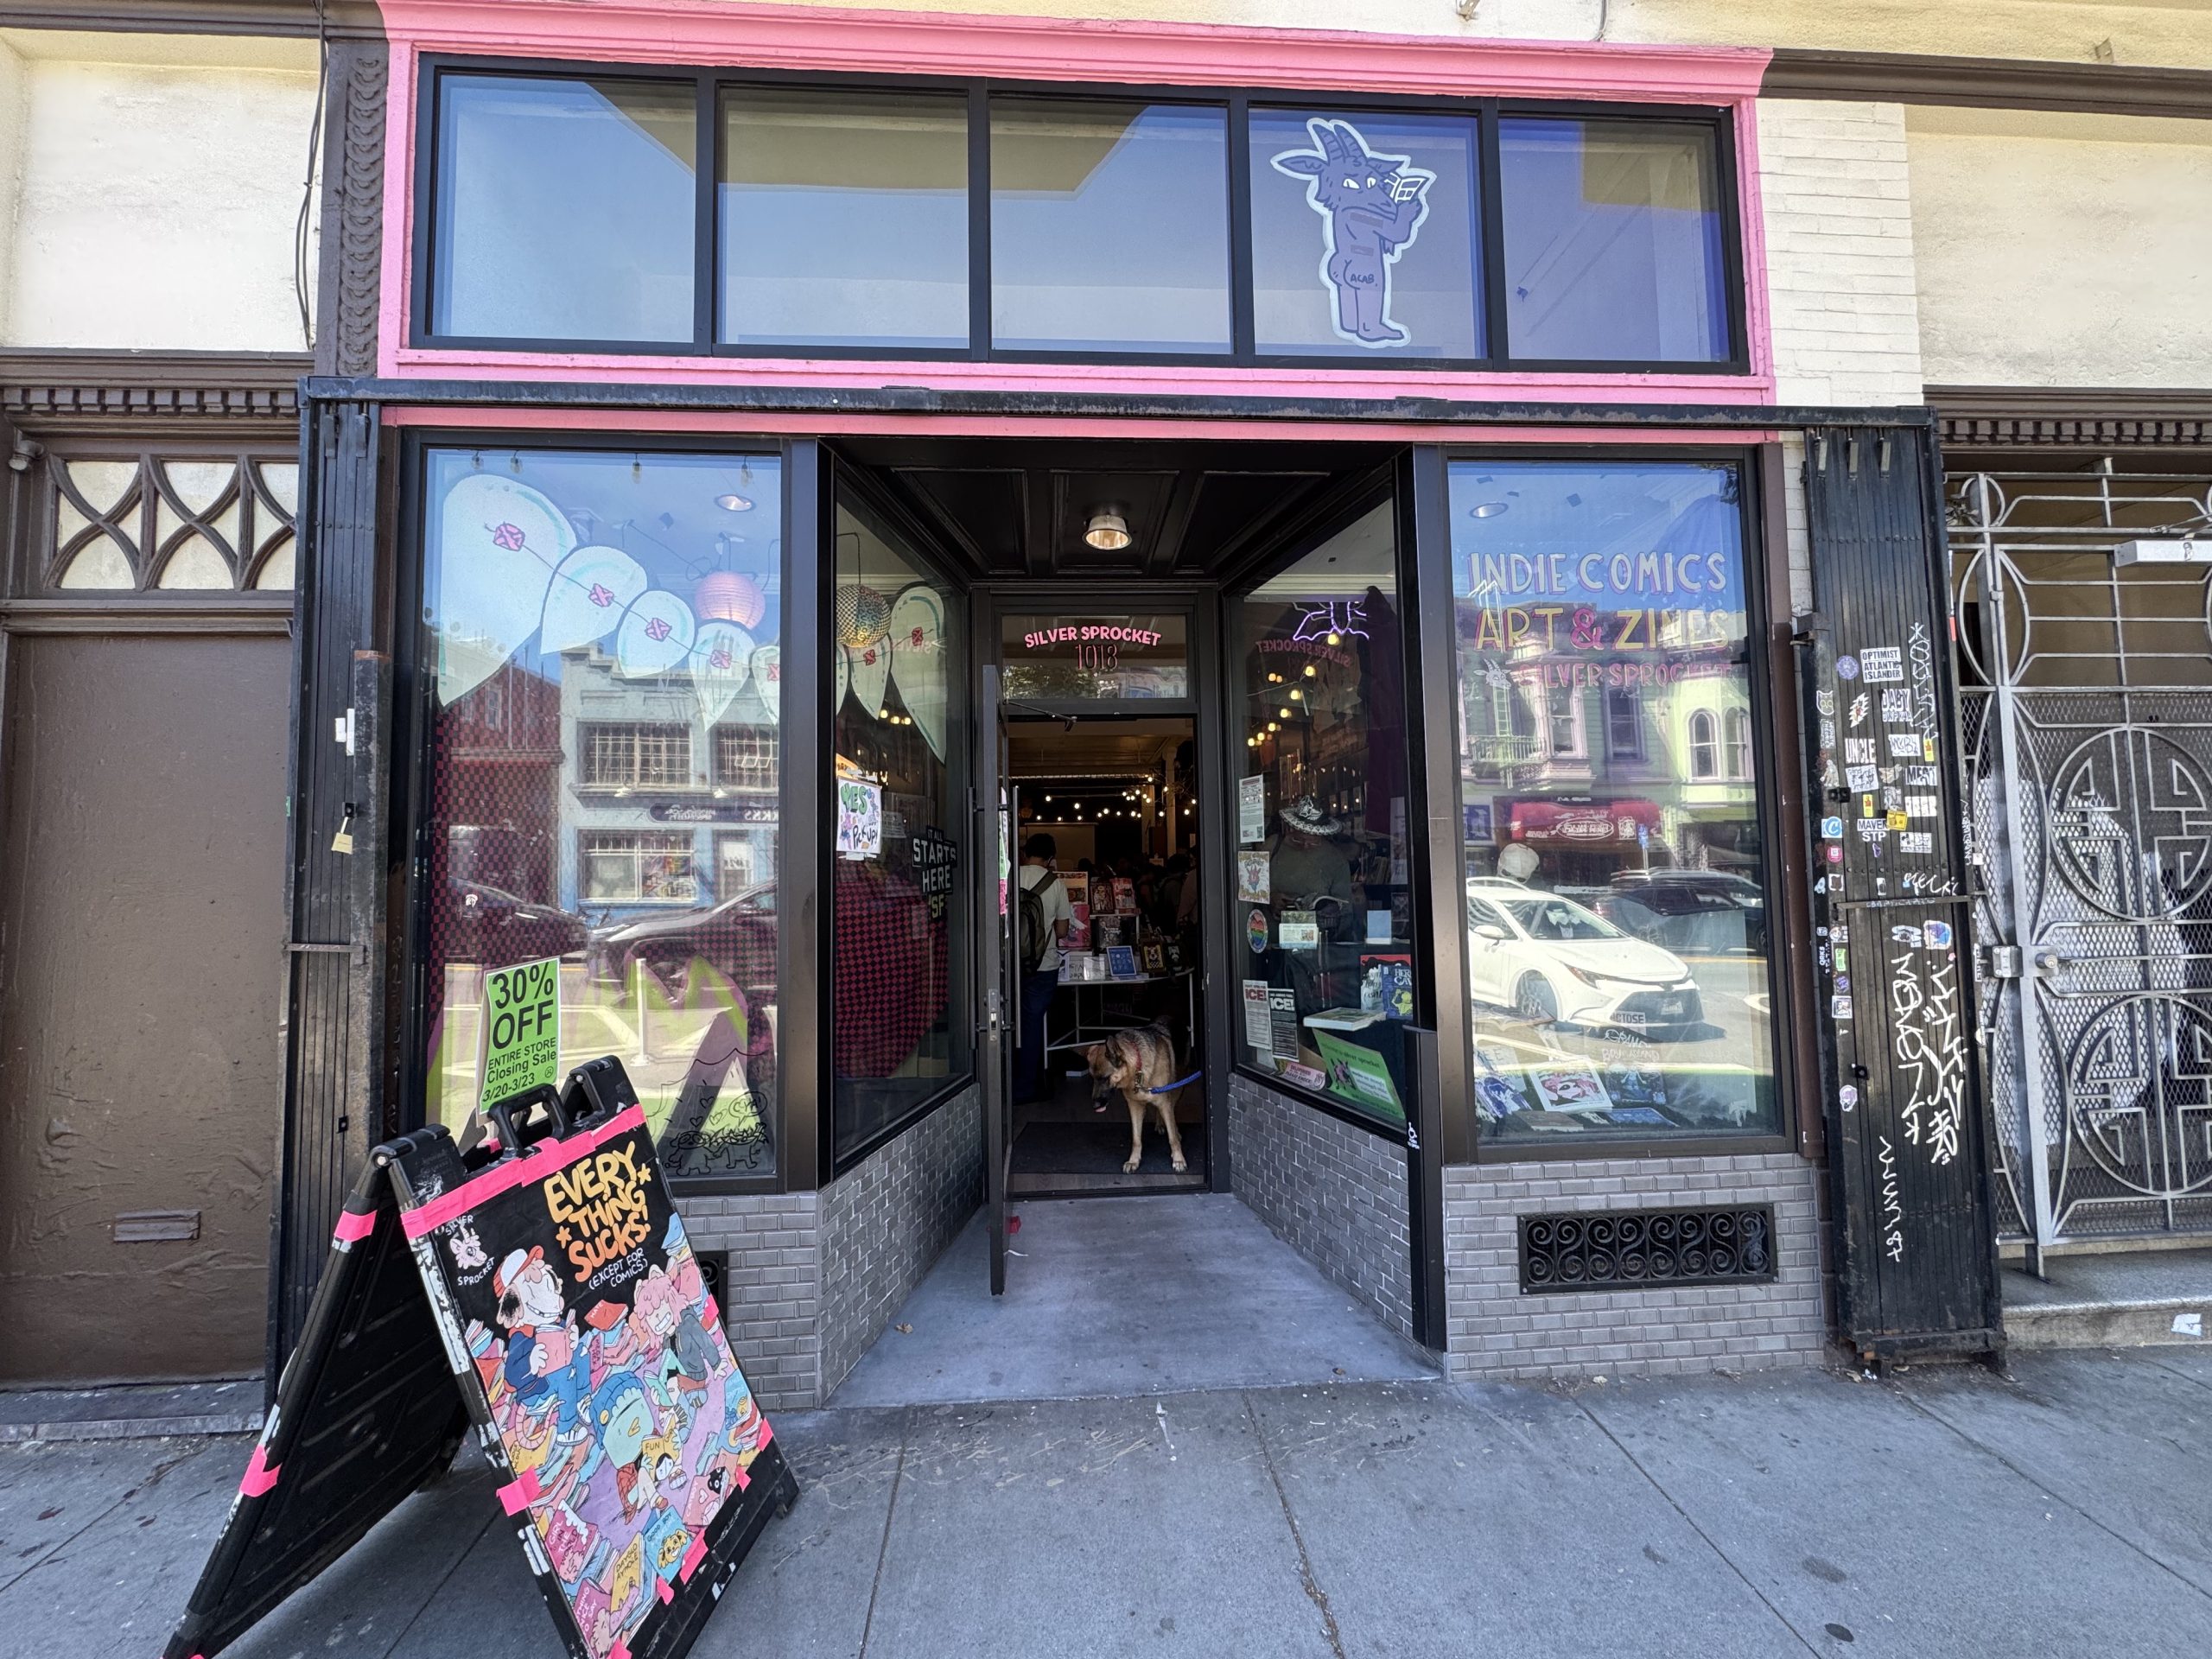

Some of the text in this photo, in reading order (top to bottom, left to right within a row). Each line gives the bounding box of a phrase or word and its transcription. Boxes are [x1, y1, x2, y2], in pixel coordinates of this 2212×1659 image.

[1350, 273, 1375, 284] ACAB
[1468, 551, 1727, 596] INDIE COMICS
[1024, 625, 1162, 648] SILVER SPROCKET
[1473, 607, 1730, 654] ART & ZINES
[1075, 643, 1118, 671] 1018
[1862, 650, 1898, 661] OPTIMIST
[1864, 660, 1901, 671] ATLANTIC
[1517, 661, 1732, 690] SILVER SPROCKET
[1865, 670, 1901, 681] ISLANDER
[1845, 738, 1876, 764] UNCLE
[840, 782, 868, 815] YES
[867, 828, 878, 846] UP!
[933, 830, 944, 842] ALL
[1862, 831, 1886, 842] STP
[912, 837, 957, 864] STARTS
[922, 864, 950, 893] HERE
[492, 962, 554, 1009] 30%
[1245, 988, 1268, 1001] ICE!
[1269, 997, 1295, 1011] ICE!
[492, 999, 554, 1050] OFF
[487, 1050, 556, 1084] Closing Sale
[488, 1037, 556, 1071] ENTIRE STORE
[482, 1072, 535, 1103] 3/20-3/23
[543, 1141, 638, 1224] EVERY
[568, 1180, 646, 1237] THING
[444, 1214, 474, 1236] SILVER
[568, 1205, 652, 1283] SUCKS!
[456, 1256, 495, 1286] SPROCKET
[588, 1247, 645, 1290] (EXCEPT FOR
[645, 1441, 660, 1452] FUN
[549, 1519, 564, 1545] GIRL
[558, 1530, 569, 1553] THE
[647, 1524, 661, 1542] GOOD
[615, 1542, 638, 1573] DAYGLO
[576, 1586, 590, 1617] THING
